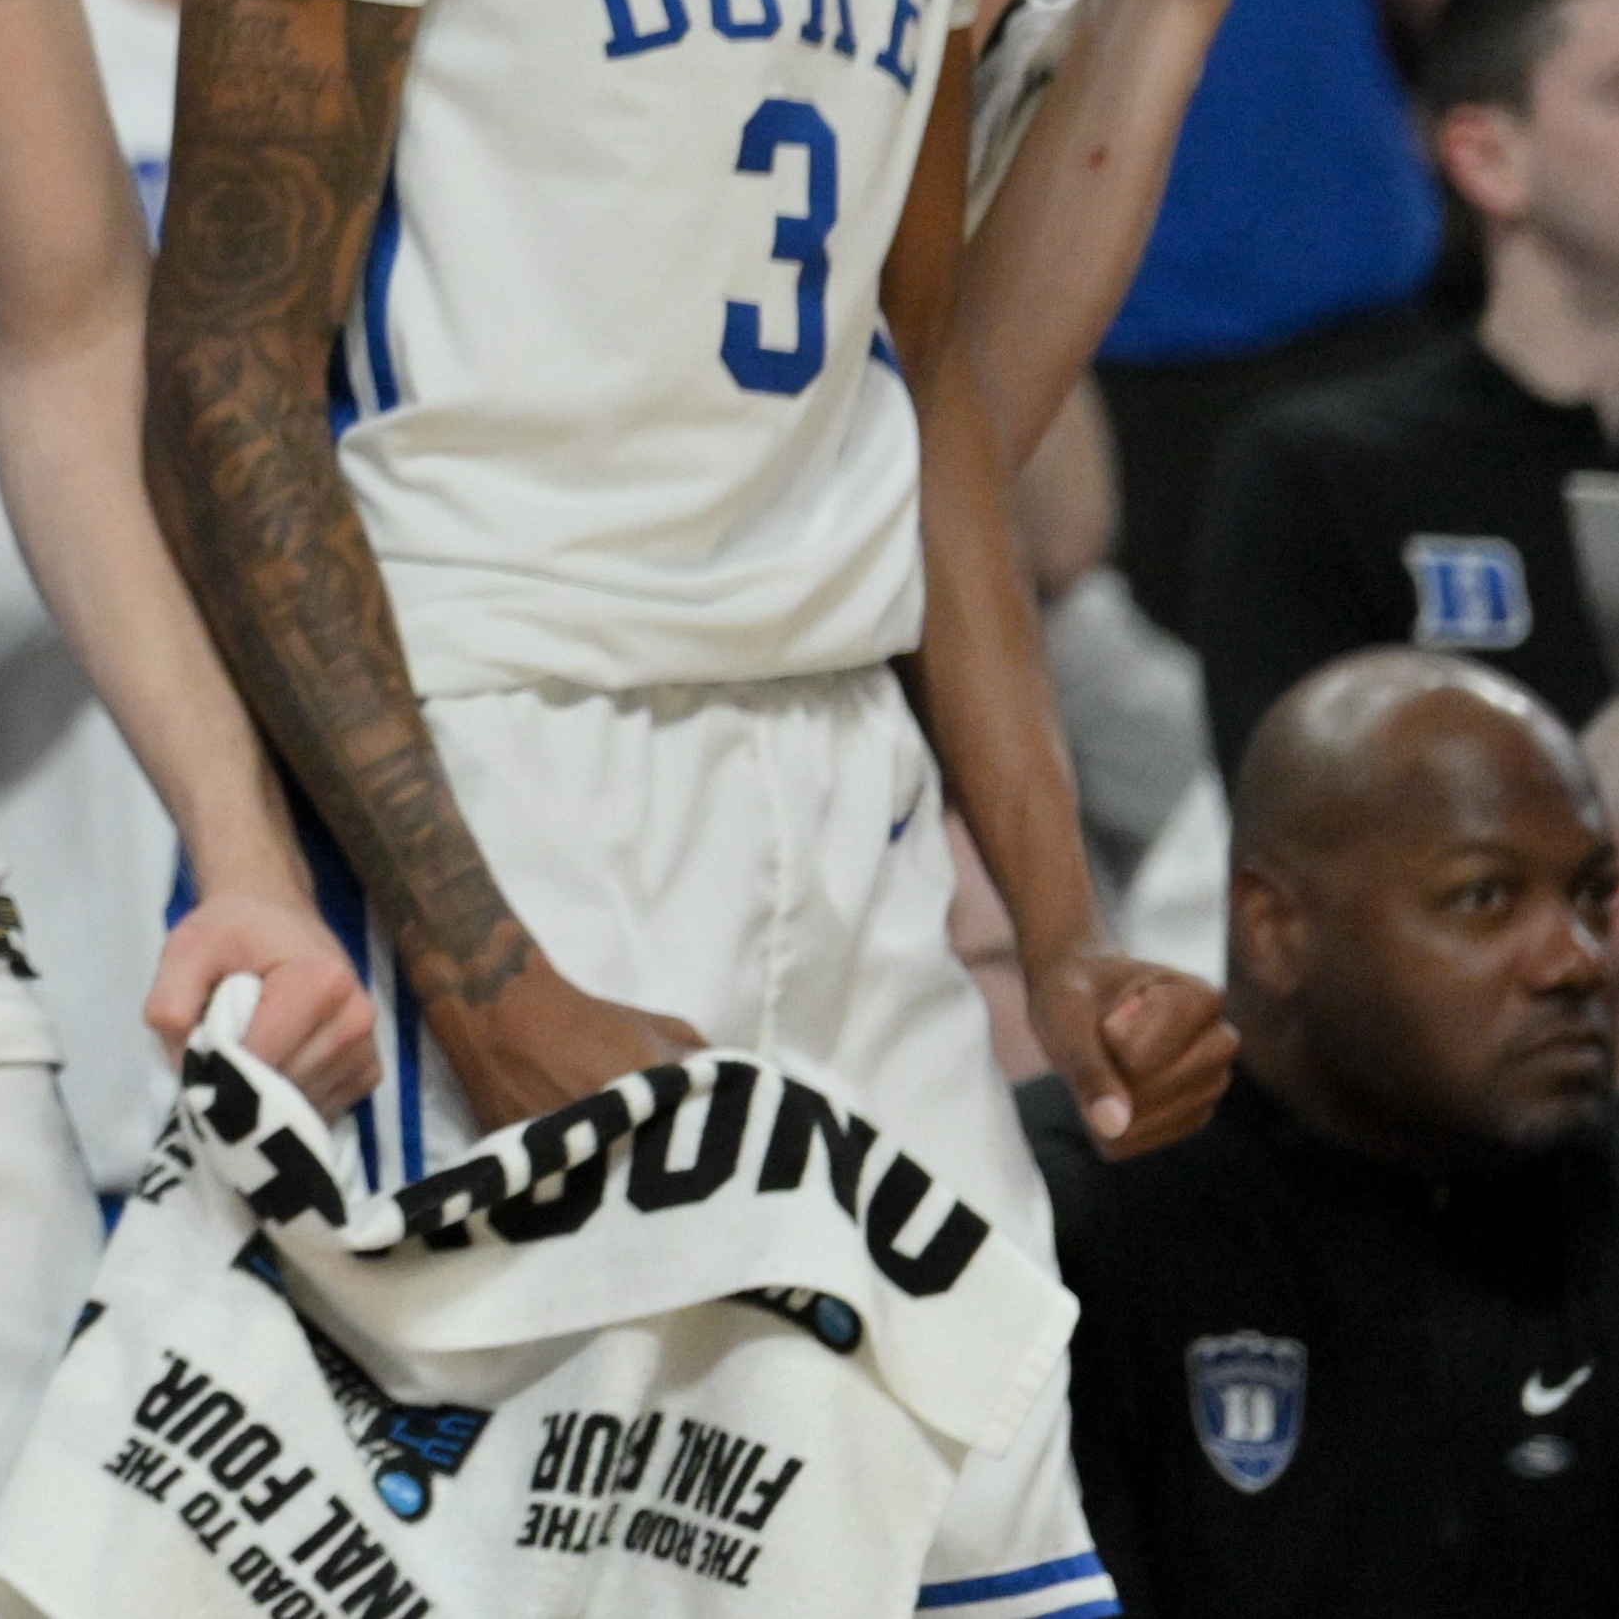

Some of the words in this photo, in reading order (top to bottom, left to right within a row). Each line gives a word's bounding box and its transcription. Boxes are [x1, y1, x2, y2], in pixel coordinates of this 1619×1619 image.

[720, 97, 840, 396] 3
[103, 1437, 185, 1504] THE
[658, 1417, 807, 1532] FINAL
[178, 1492, 241, 1555] TO
[515, 1501, 599, 1555] THE
[696, 1526, 763, 1588] THE
